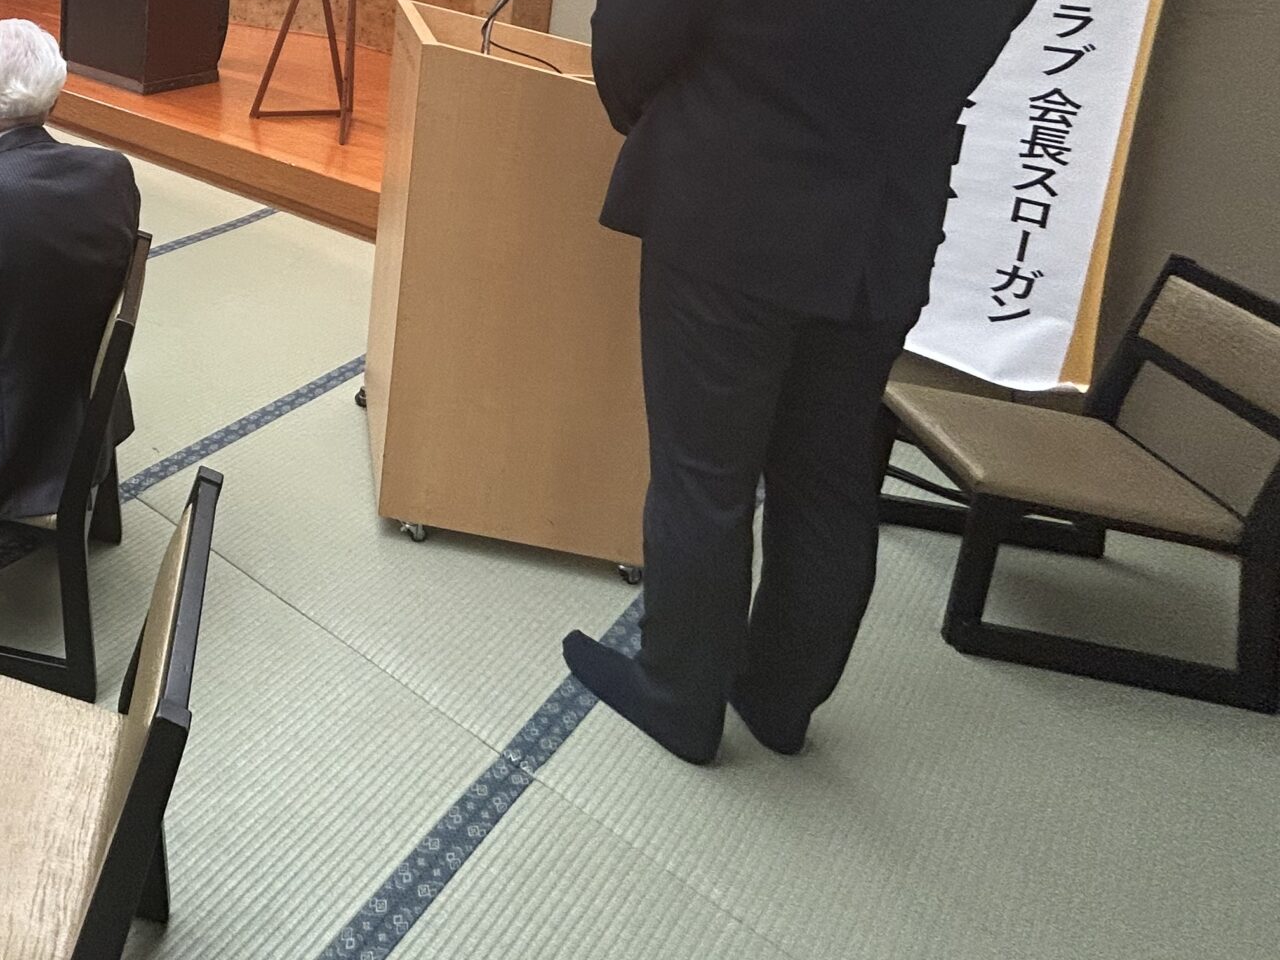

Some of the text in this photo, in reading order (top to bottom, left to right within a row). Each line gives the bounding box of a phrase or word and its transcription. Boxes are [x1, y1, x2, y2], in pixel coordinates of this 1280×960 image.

[987, 87, 1082, 323] 会長スローガン
